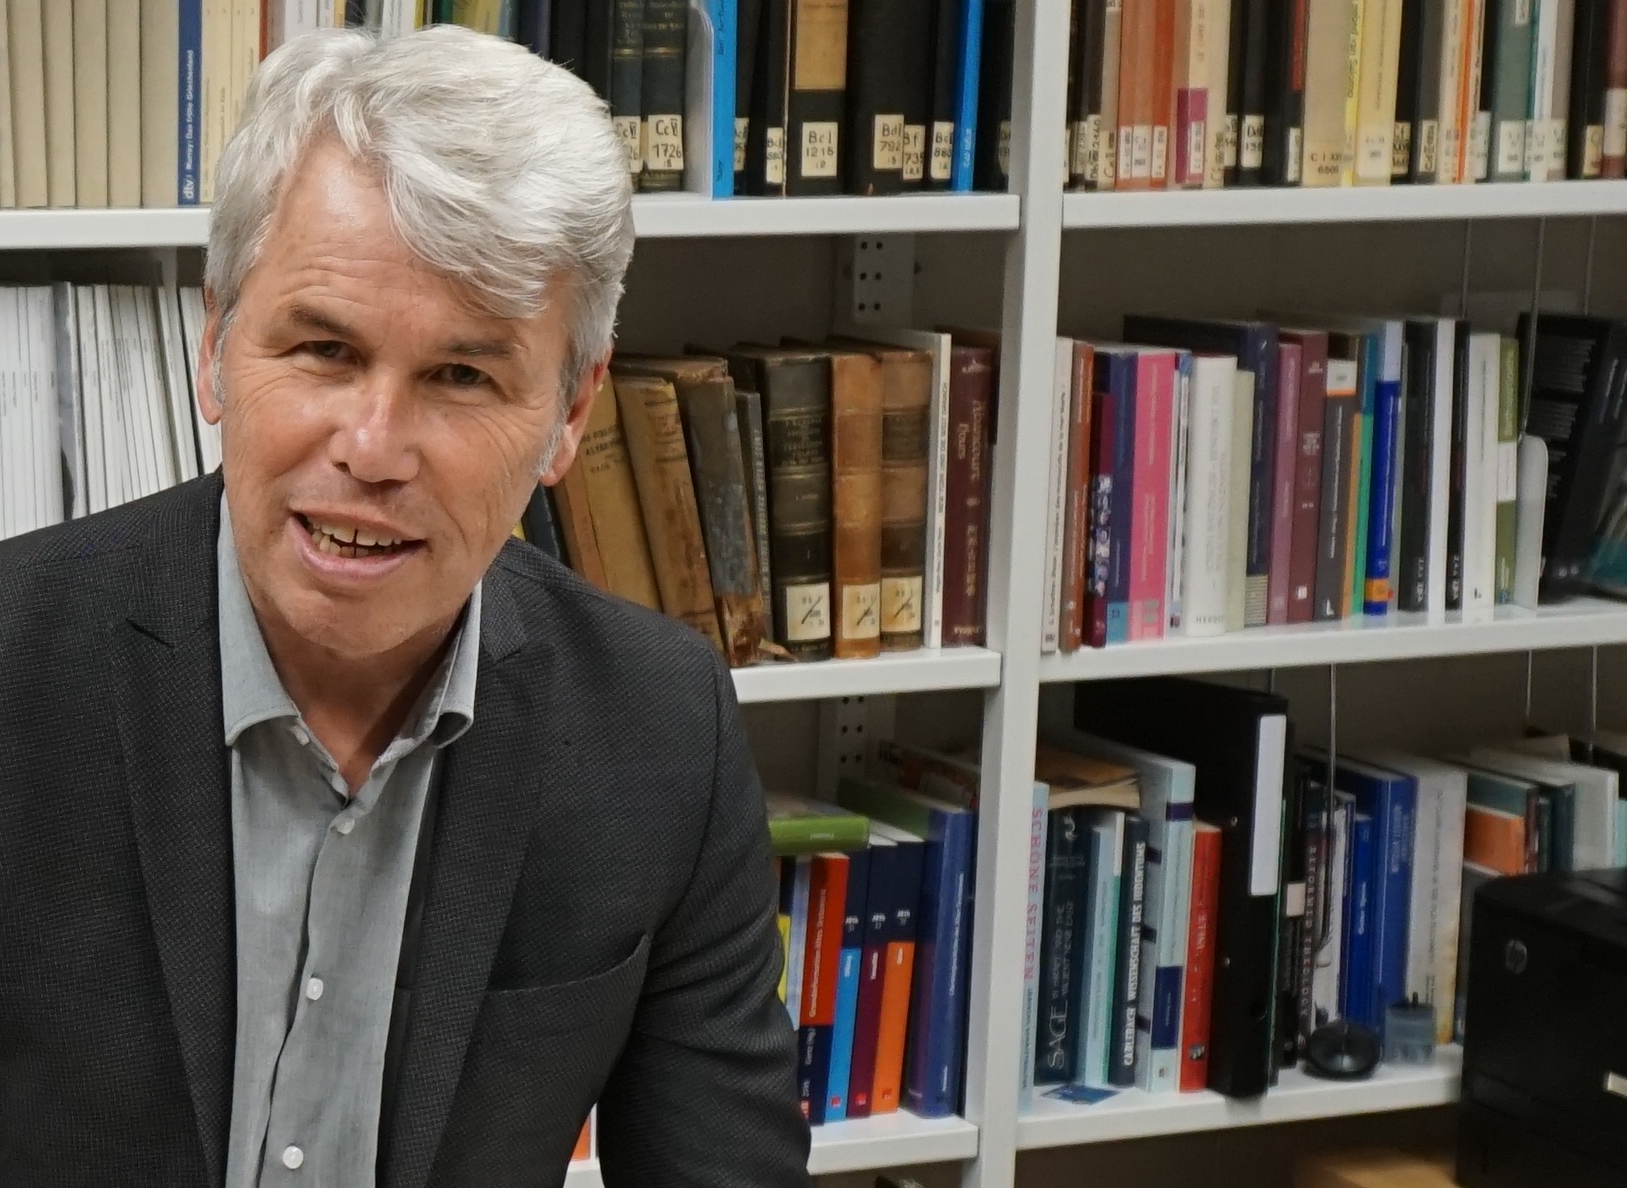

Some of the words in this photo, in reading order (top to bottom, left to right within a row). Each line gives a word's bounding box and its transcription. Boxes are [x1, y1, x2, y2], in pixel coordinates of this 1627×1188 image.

[652, 142, 682, 159] 1726
[182, 178, 195, 200] dtv
[1028, 808, 1044, 894] SCHÖNE
[1132, 842, 1146, 902] JUDENTUMS
[814, 888, 827, 928] Testament
[1131, 904, 1143, 924] DES
[1304, 845, 1318, 929] REFORMED
[1022, 903, 1038, 981] SEITEN
[1126, 924, 1142, 1001] WISSENSCHAFT
[1300, 937, 1313, 1017] THEOLOGY
[1046, 999, 1068, 1070] SAGE
[1122, 1007, 1136, 1066] CARLEBACH
